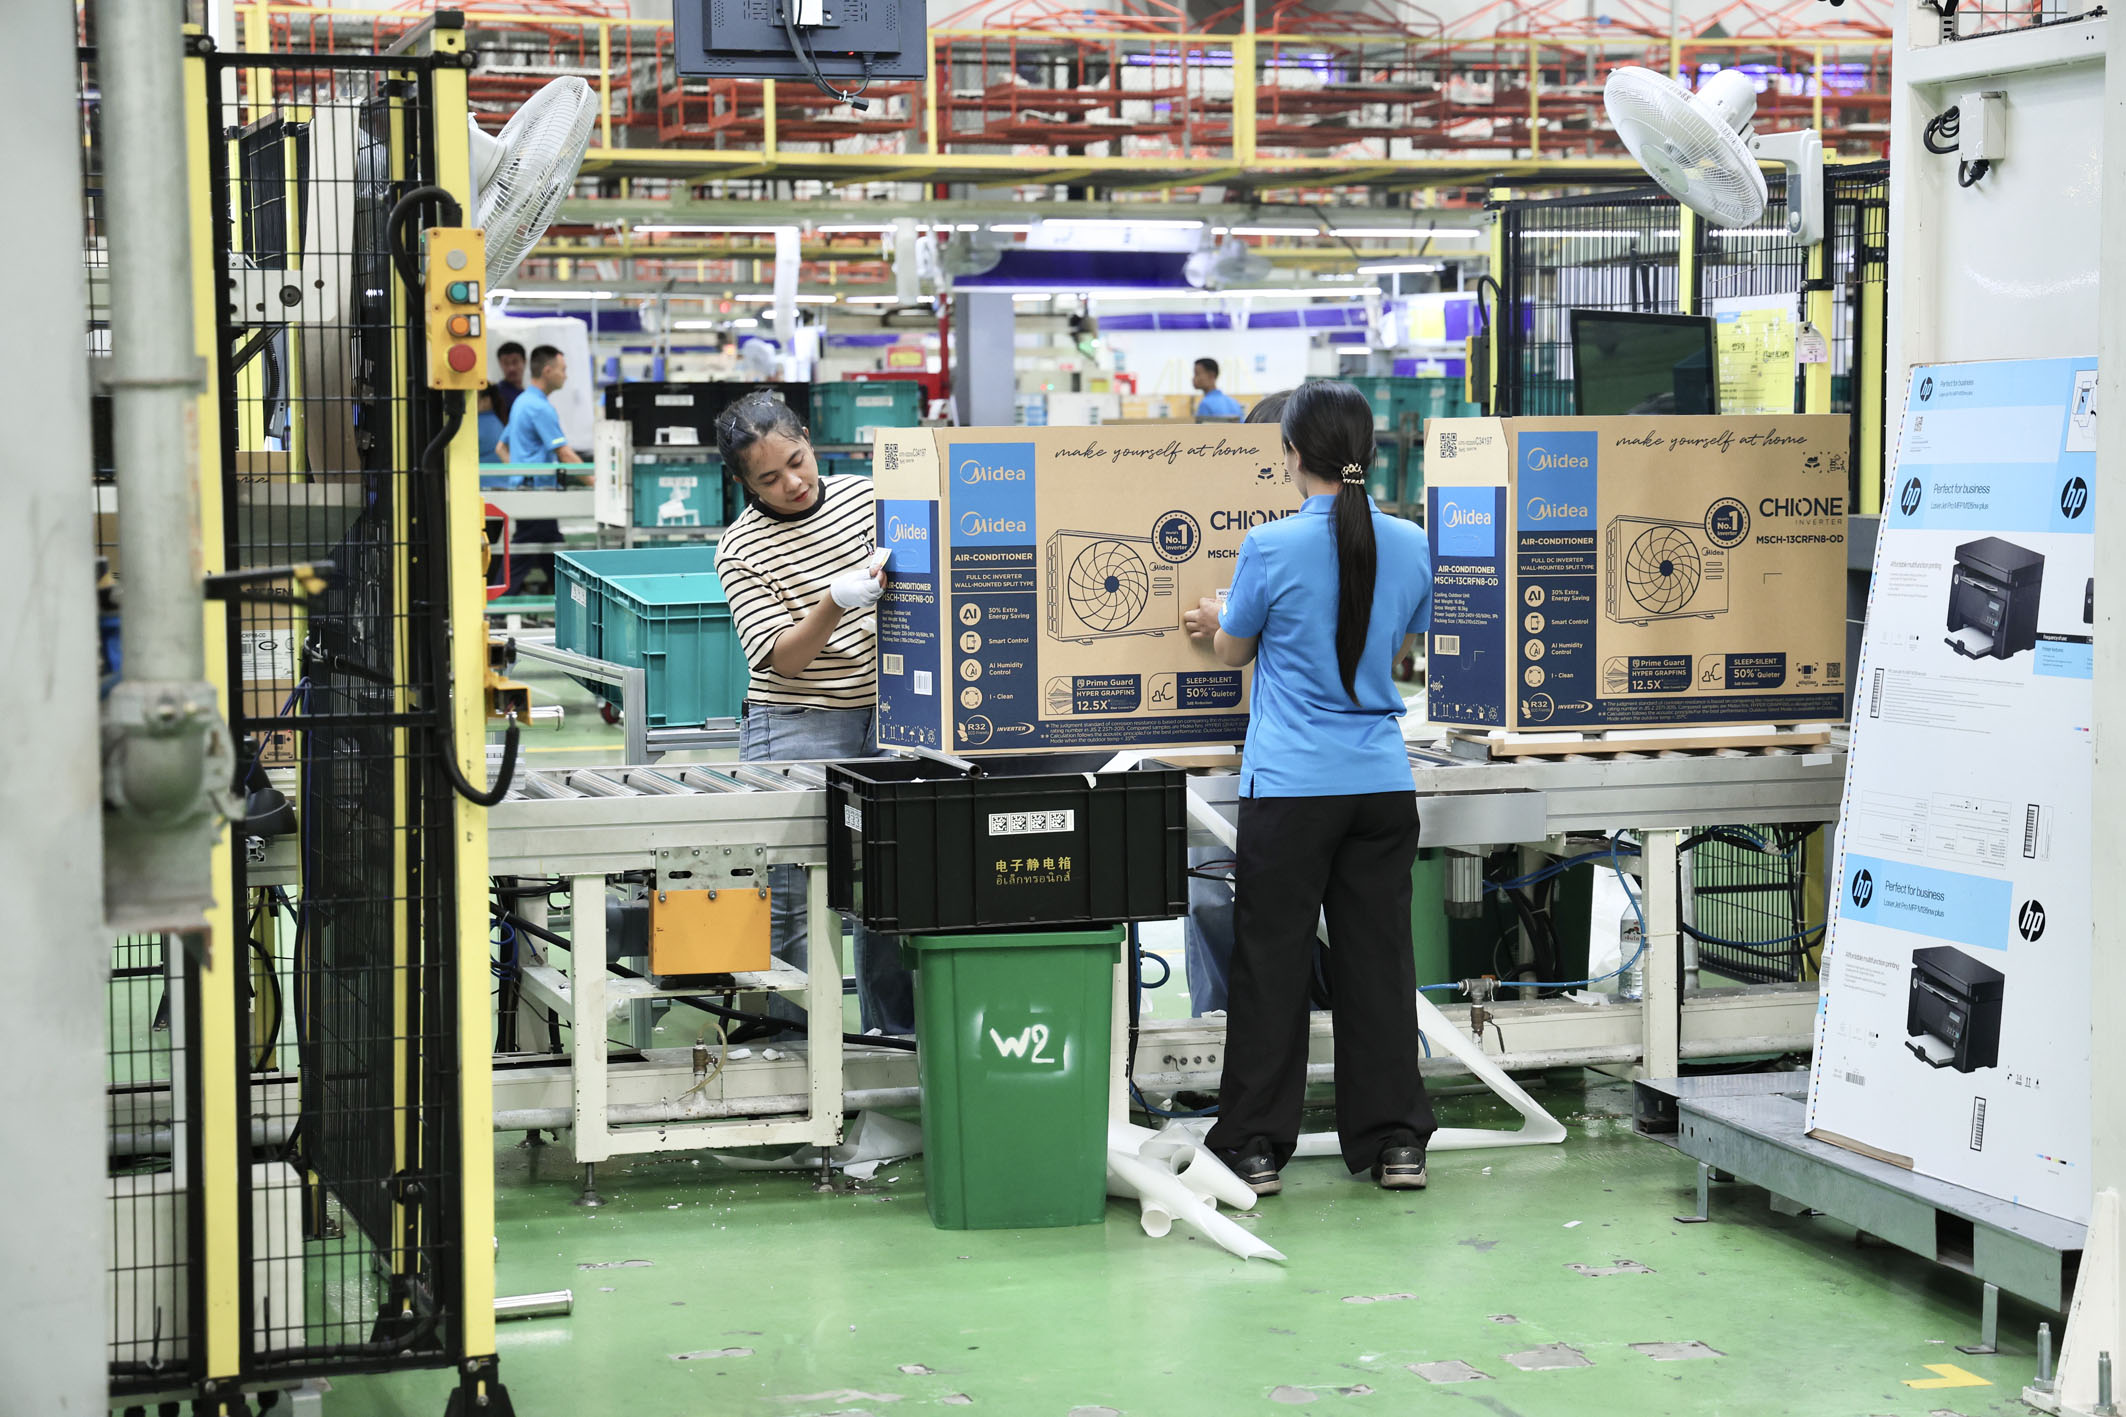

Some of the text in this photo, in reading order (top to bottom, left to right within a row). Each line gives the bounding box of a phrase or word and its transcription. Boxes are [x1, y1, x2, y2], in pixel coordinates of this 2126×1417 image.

[1920, 377, 1933, 402] hp
[1616, 428, 1808, 453] make yourself at home
[1055, 439, 1260, 465] make yourself at home
[1527, 447, 1589, 471] Midea
[960, 459, 1026, 484] Midea
[1901, 477, 1922, 517] hp
[1933, 483, 1991, 494] Perfect for business
[2061, 476, 2088, 520] hp
[1443, 502, 1491, 528] Midea
[1527, 497, 1589, 521] Midea
[1759, 497, 1843, 517] CHIONE
[888, 515, 927, 542] Midea
[960, 511, 1026, 536] Midea
[1521, 538, 1594, 546] AIR-CONDITIONER
[1756, 534, 1844, 545] MSCH-13CRFN8-OD
[954, 552, 1033, 562] AIR-CONDITIONER
[1702, 547, 1725, 556] Midea
[1149, 562, 1174, 571] Midea
[1438, 565, 1495, 574] AIR-CONDITIONER
[1434, 576, 1499, 586] MSCH-13CRFN8-OD
[1086, 678, 1133, 687] Prime Guard
[1186, 676, 1232, 684] SLEEP-SILENT
[995, 856, 1071, 873] 电子静电箱
[996, 870, 1071, 886] อิเล็กทรอนิกส์
[1852, 869, 1873, 909] hp
[1885, 880, 1945, 901] Perfect for business
[2018, 899, 2046, 942] hp
[989, 1024, 1055, 1063] W2
